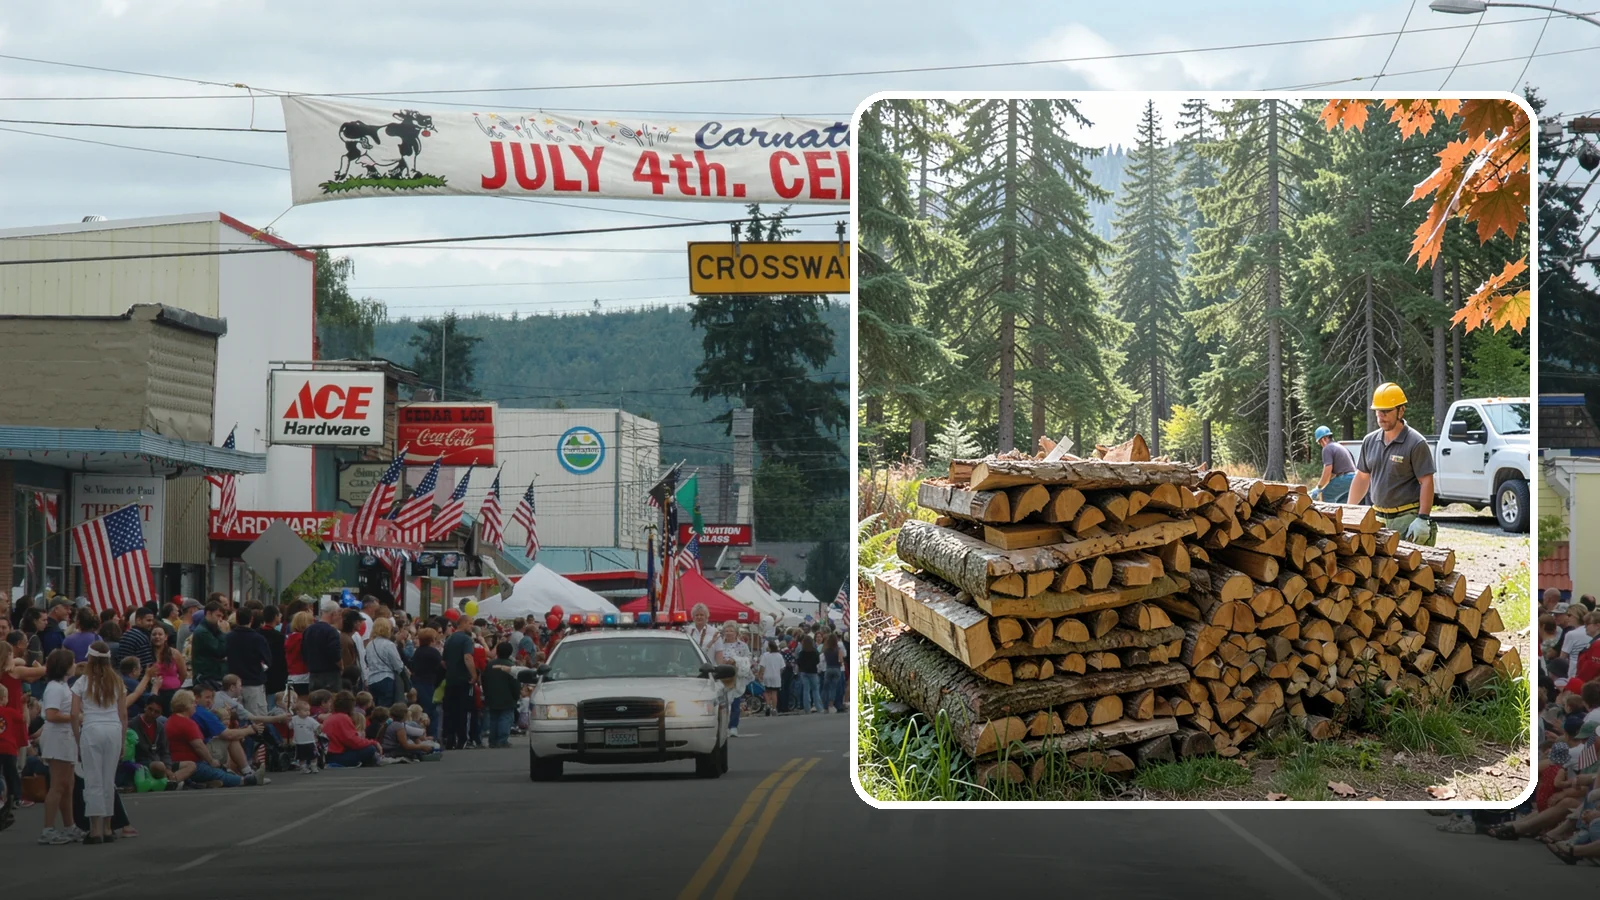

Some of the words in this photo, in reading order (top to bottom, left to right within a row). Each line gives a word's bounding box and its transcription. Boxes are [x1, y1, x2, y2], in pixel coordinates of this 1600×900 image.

[695, 121, 850, 150] Carnat
[481, 141, 604, 192] JULY
[632, 150, 746, 198] 4th.
[283, 380, 373, 420] ACE
[405, 409, 452, 422] CEDAR
[283, 421, 371, 436] Hardware
[416, 428, 477, 447] Coca-Cola
[353, 467, 384, 481] Simpl
[95, 485, 124, 495] Vincent
[126, 486, 136, 495] de
[137, 486, 155, 495] Paul
[688, 526, 741, 535] CRNATION
[699, 535, 730, 543] GLASS
